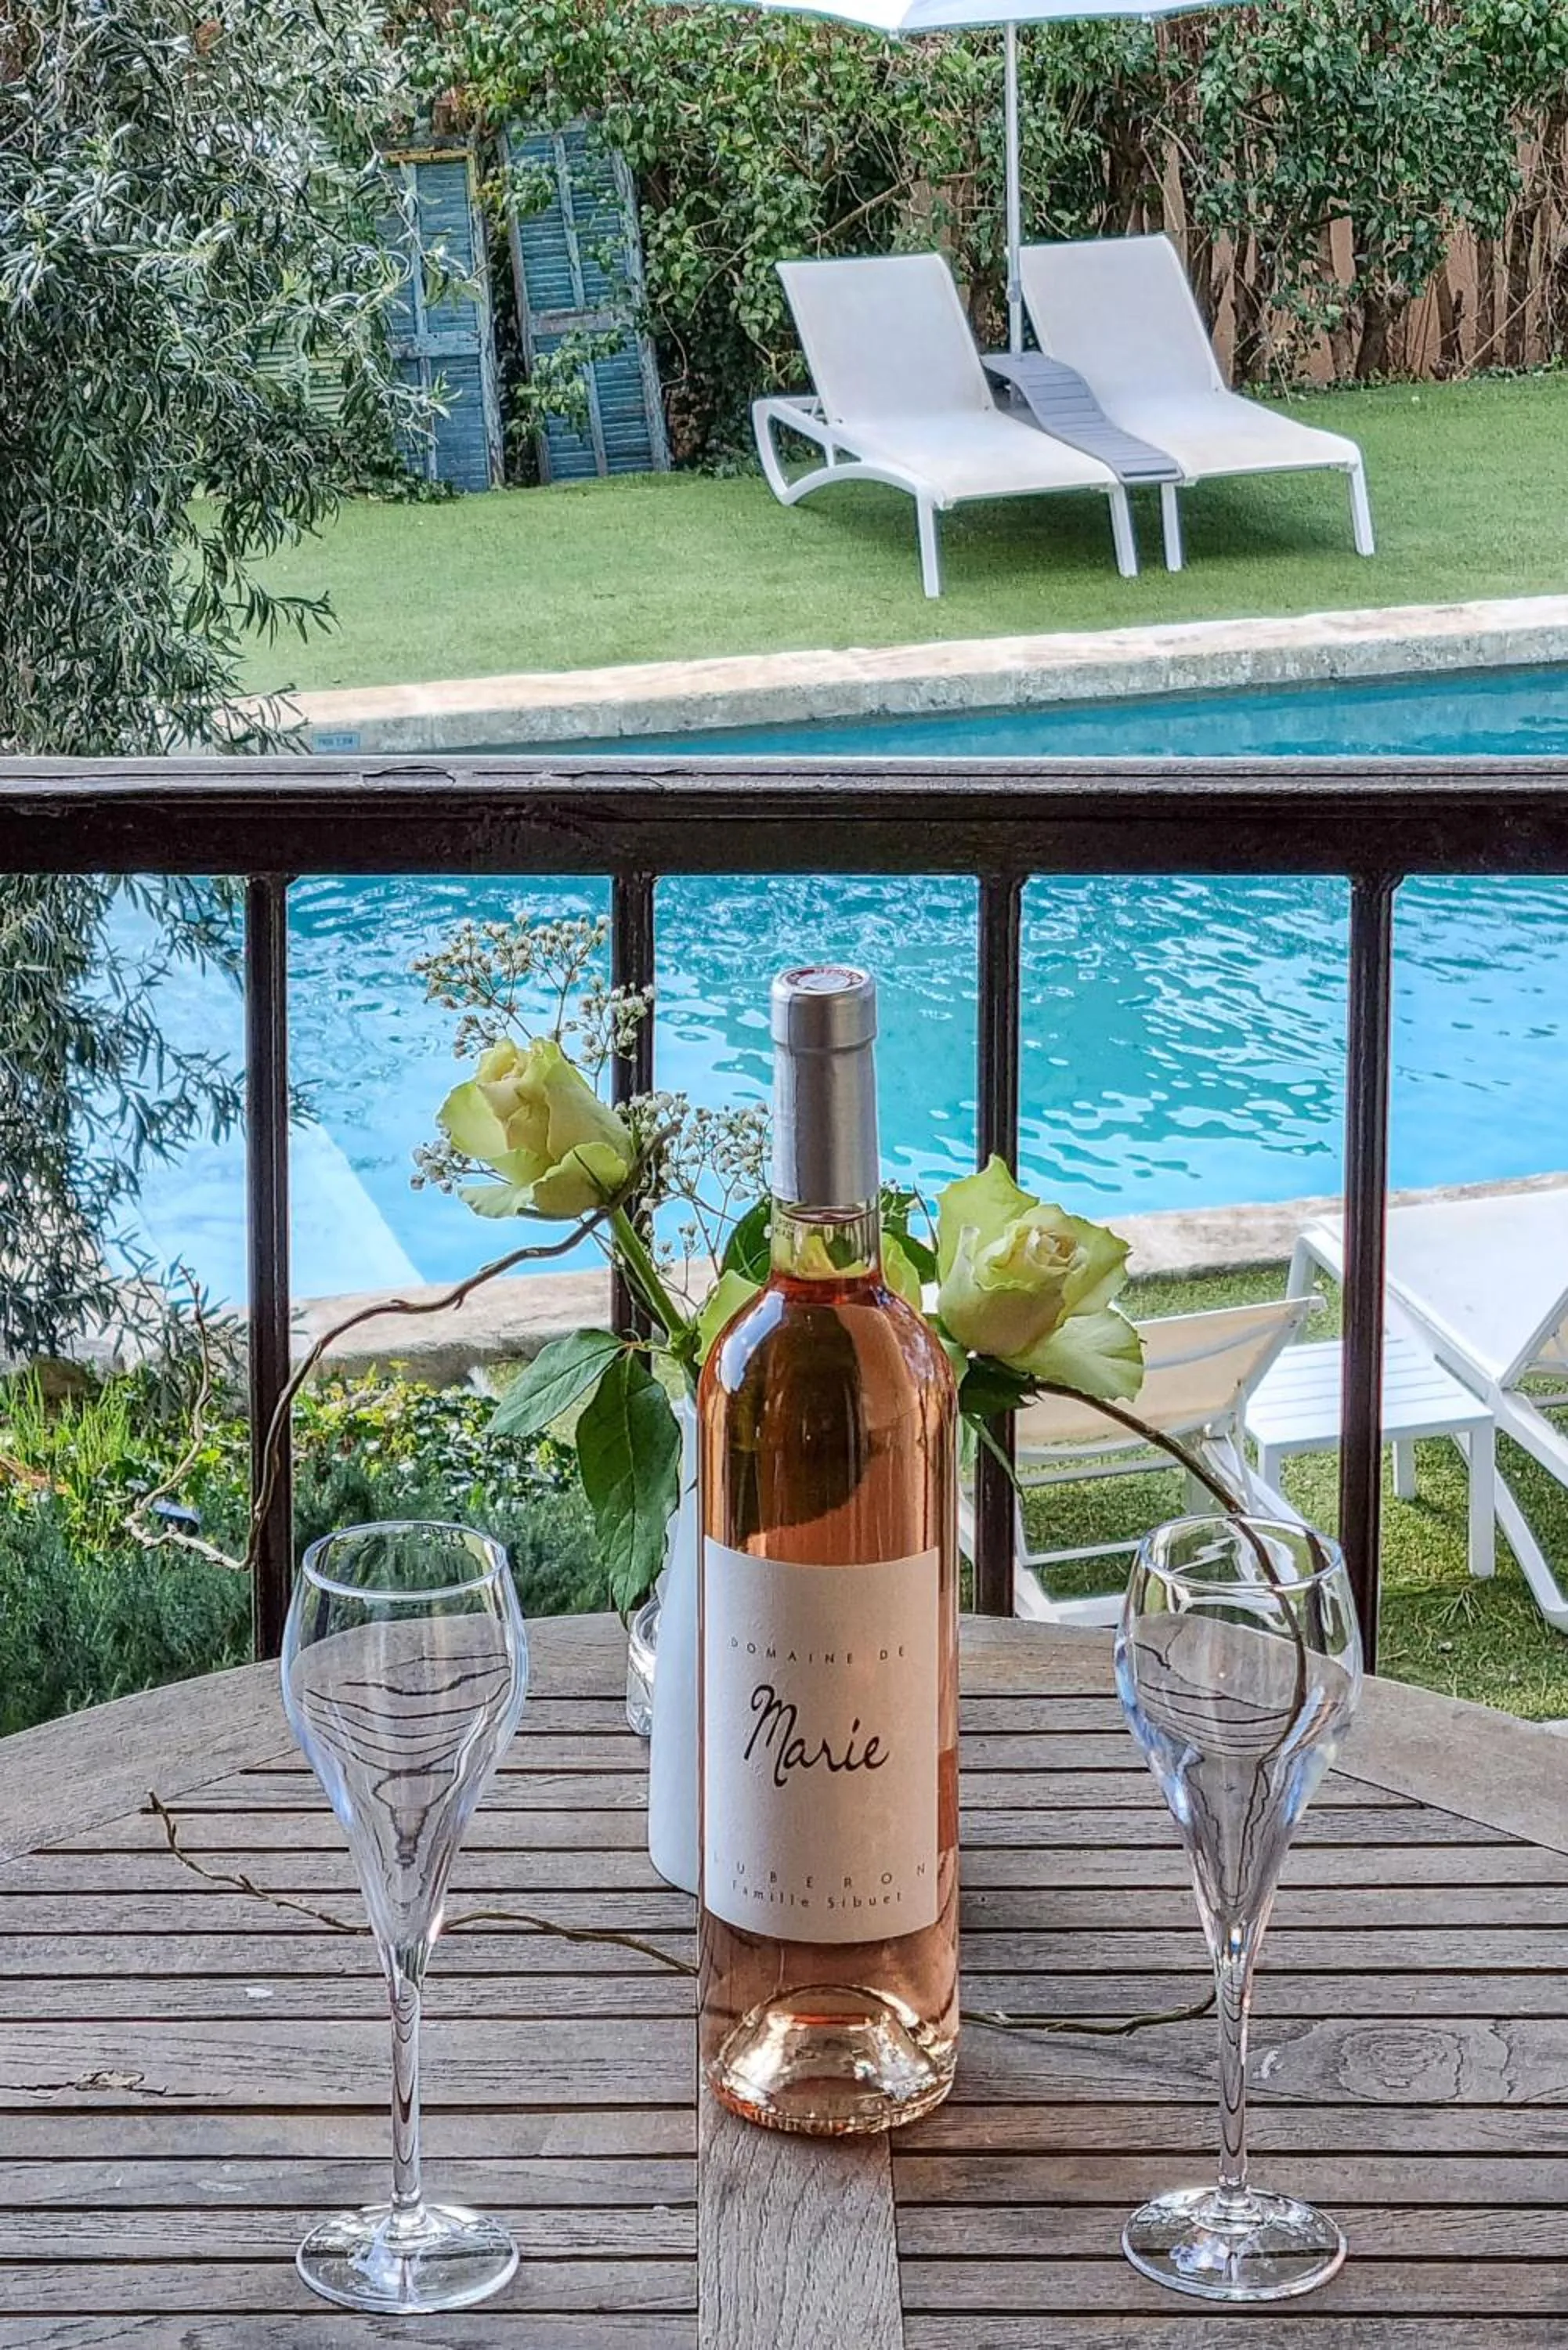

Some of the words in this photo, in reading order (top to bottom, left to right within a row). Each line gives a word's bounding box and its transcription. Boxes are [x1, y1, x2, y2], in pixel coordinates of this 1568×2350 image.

[730, 1636, 854, 1664] DOMAINE
[879, 1646, 905, 1661] DE
[743, 1685, 889, 1787] Marie
